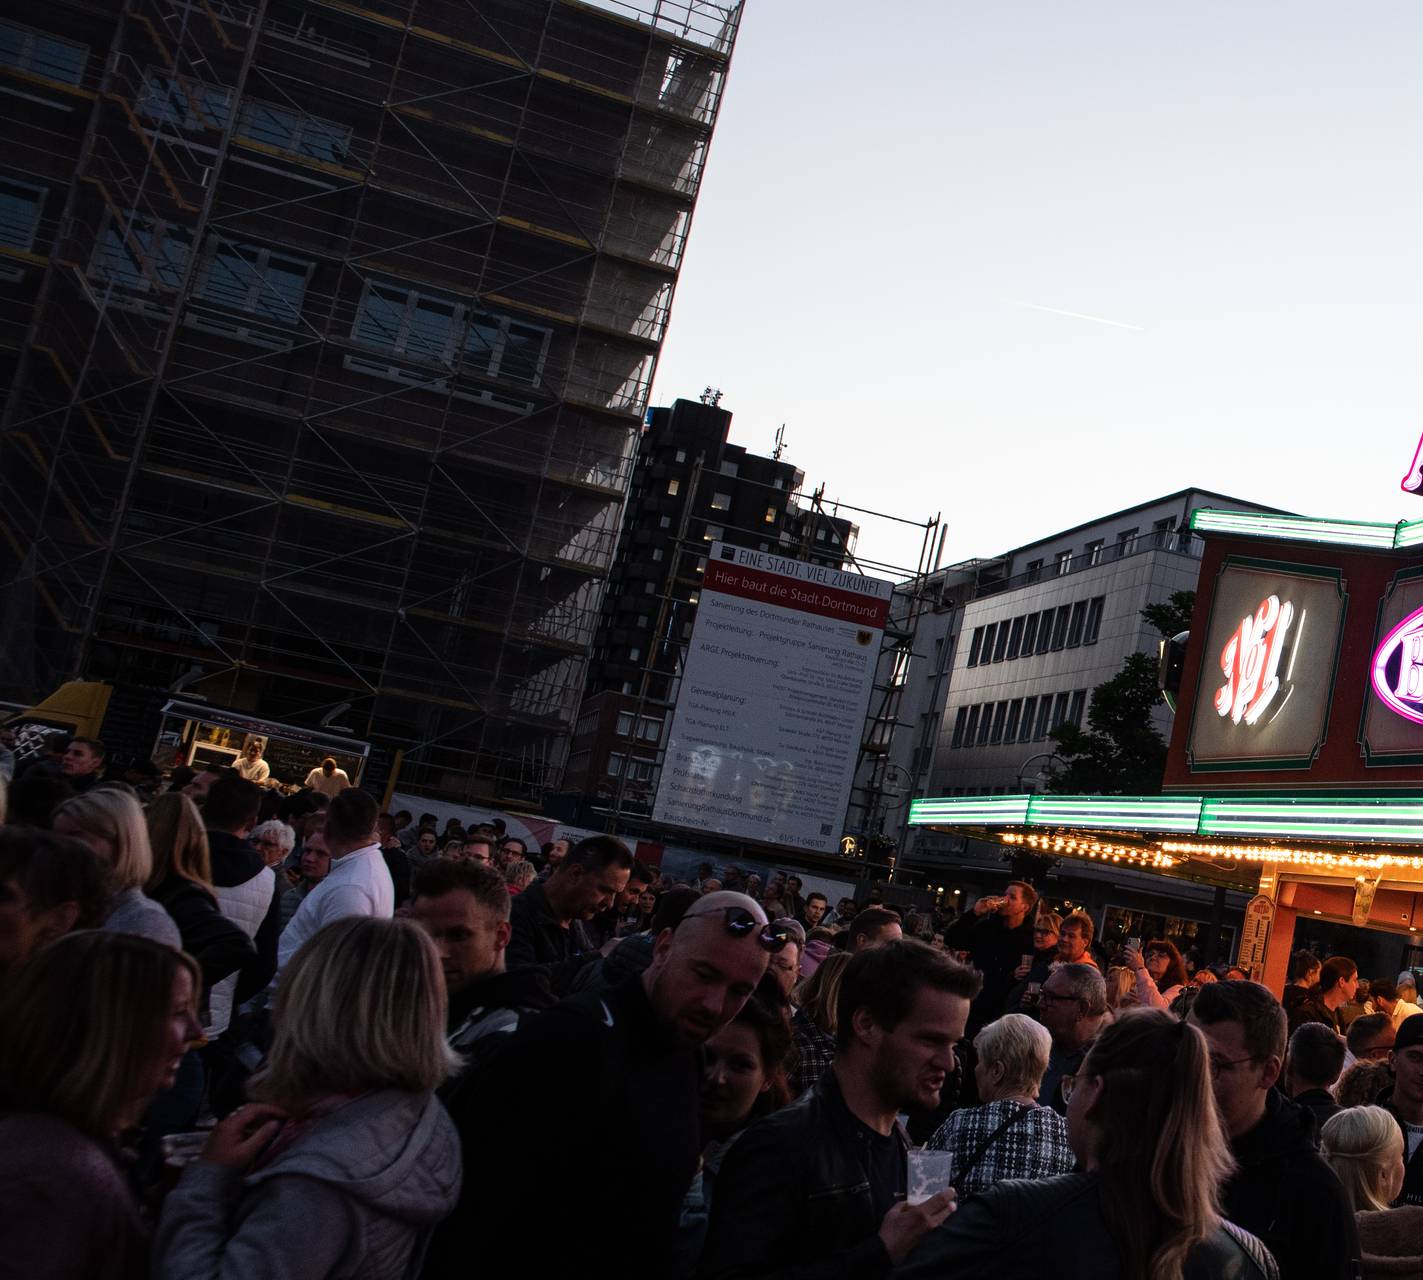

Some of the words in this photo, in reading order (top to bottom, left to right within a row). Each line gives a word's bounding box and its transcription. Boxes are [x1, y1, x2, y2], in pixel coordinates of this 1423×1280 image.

[714, 570, 739, 586] Hier
[741, 576, 767, 594] baut
[769, 582, 788, 598] die
[821, 595, 878, 619] Dortmund
[739, 550, 764, 569] EINE
[767, 556, 802, 578] STADT.
[806, 566, 829, 584] VIEL
[831, 572, 883, 597] ZUKUNFT.
[711, 598, 745, 616] Sanierung
[747, 606, 760, 616] des
[760, 609, 802, 627] Dortmunder
